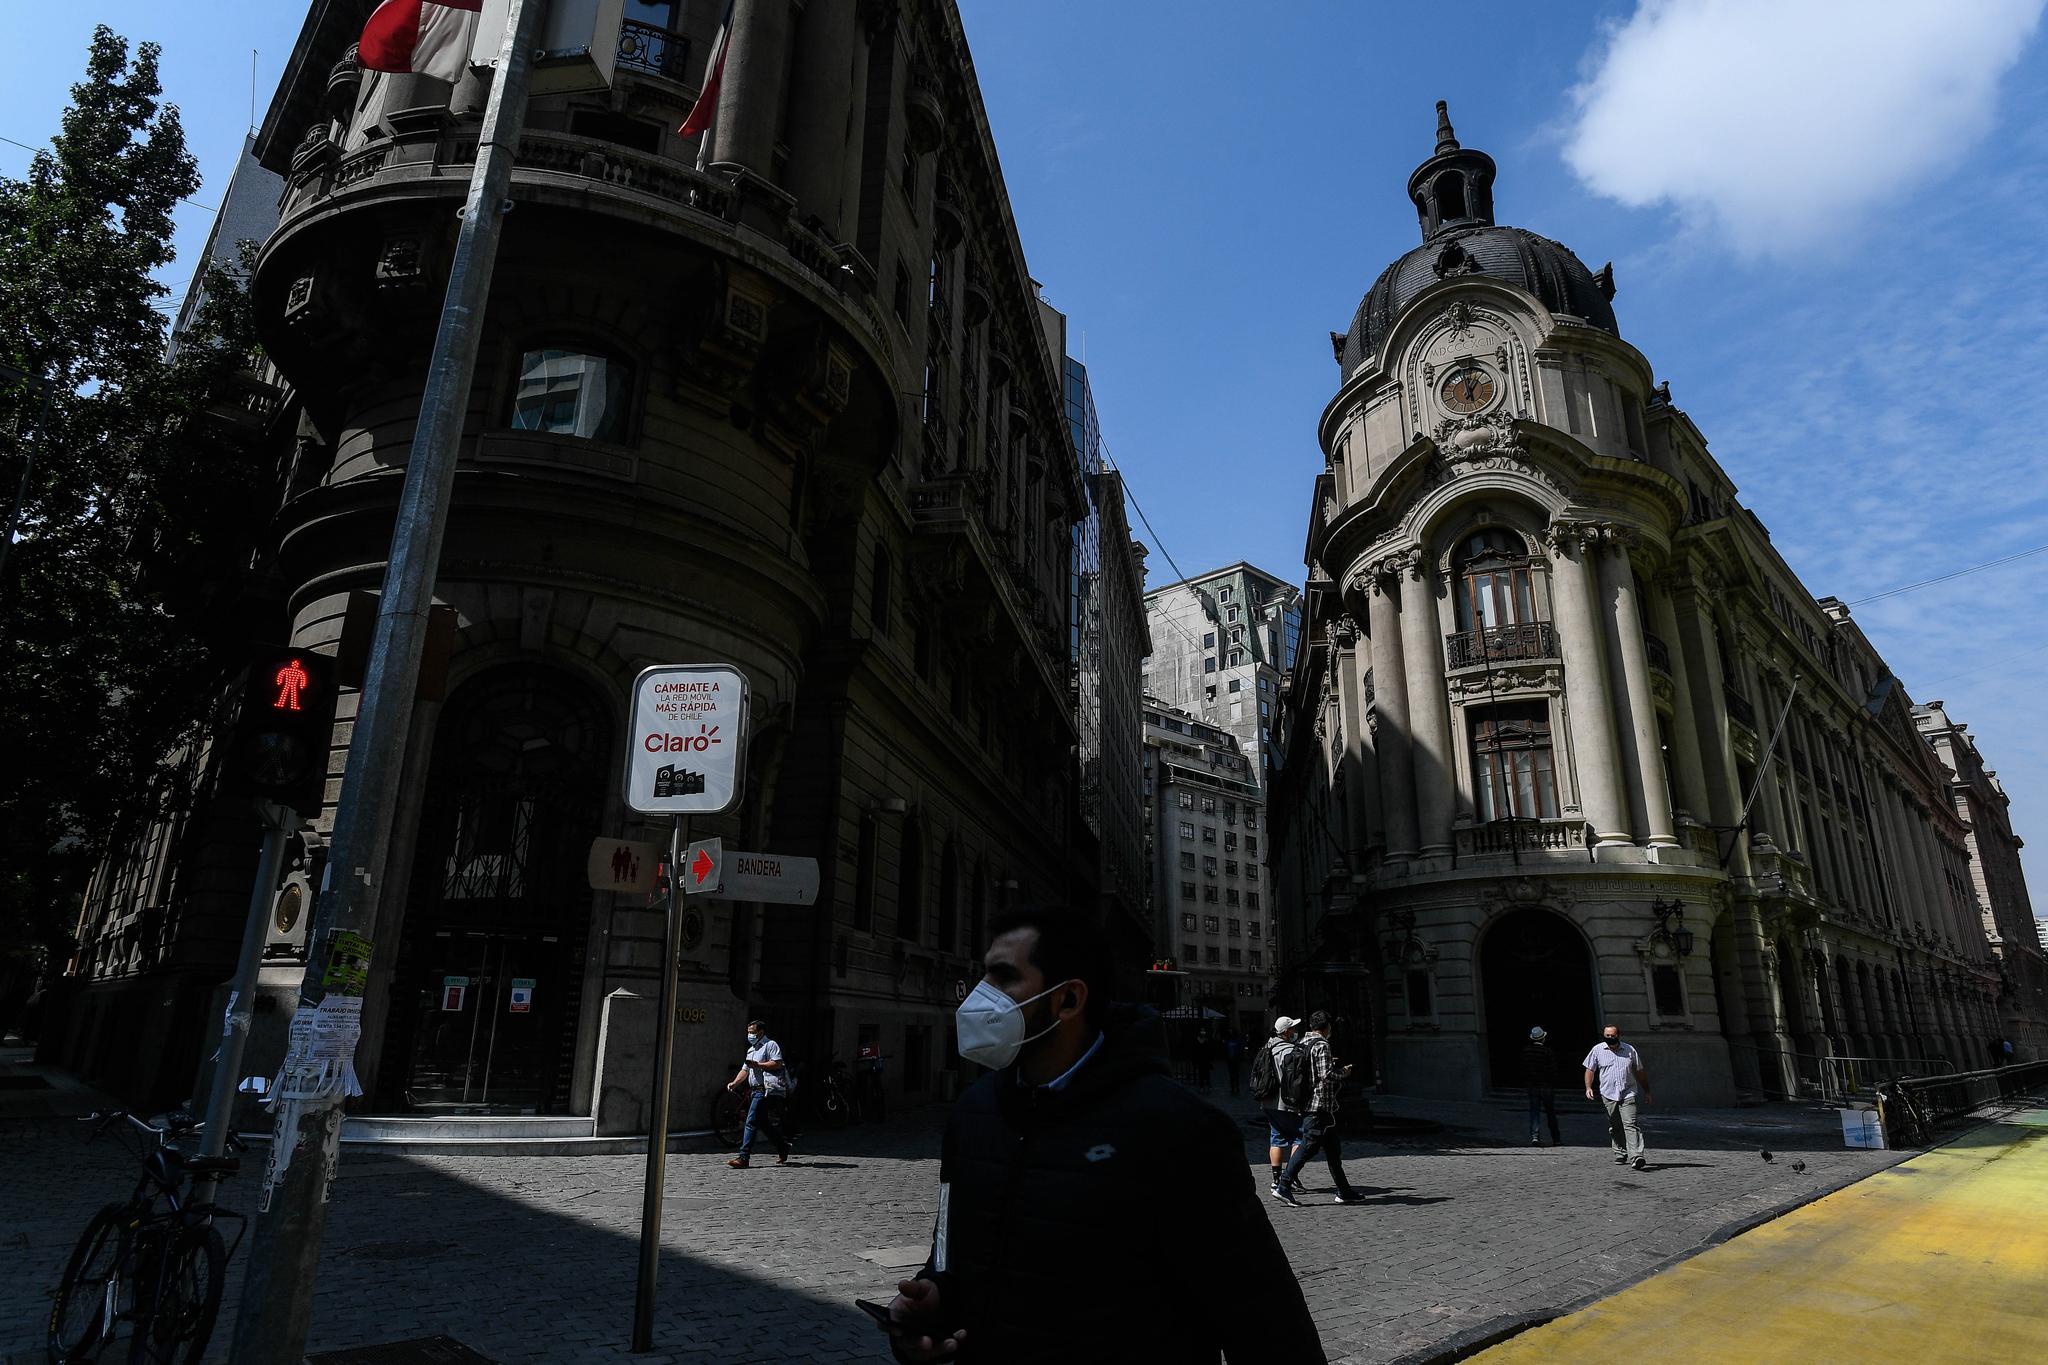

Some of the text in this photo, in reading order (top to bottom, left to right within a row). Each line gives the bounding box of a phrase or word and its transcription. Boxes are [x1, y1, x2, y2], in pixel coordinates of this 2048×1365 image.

[711, 682, 720, 692] A
[660, 694, 671, 702] LA
[672, 693, 688, 702] RED
[655, 701, 717, 713] MÁS RÁPIDA
[668, 712, 703, 721] DE CHILE
[644, 732, 710, 753] Claro
[737, 857, 782, 877] BANDERA
